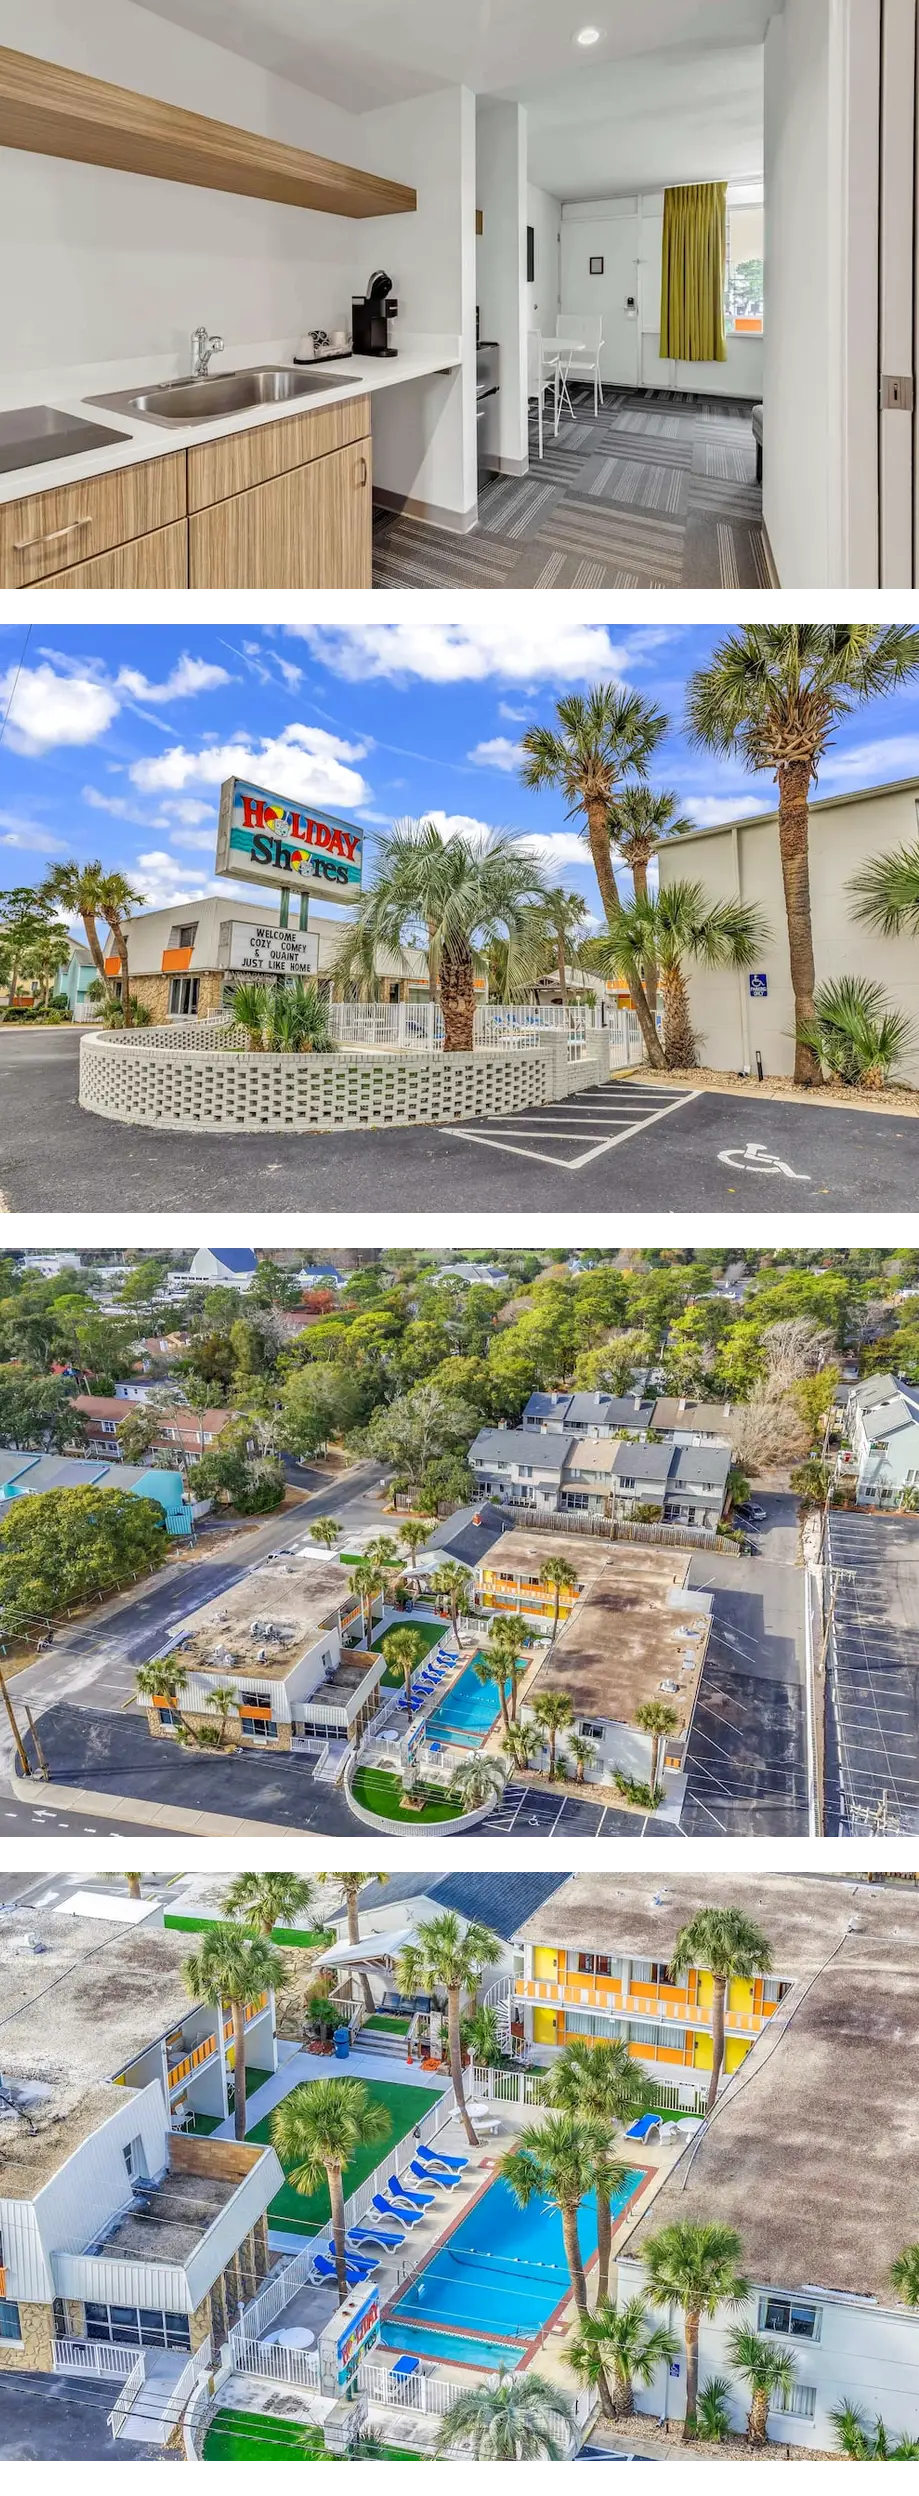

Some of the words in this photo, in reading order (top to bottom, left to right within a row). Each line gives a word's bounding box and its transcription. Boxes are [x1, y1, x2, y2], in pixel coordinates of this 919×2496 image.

[241, 796, 361, 862] HOLIDAY
[251, 833, 349, 884] Shores
[256, 928, 296, 942] WELCOME
[250, 938, 271, 949] COZY
[281, 942, 307, 953] COMFY
[255, 949, 260, 957] &
[270, 950, 299, 961] QUAINT
[242, 958, 263, 967] JUST
[268, 960, 285, 970] LIKE
[290, 963, 311, 972] HOME
